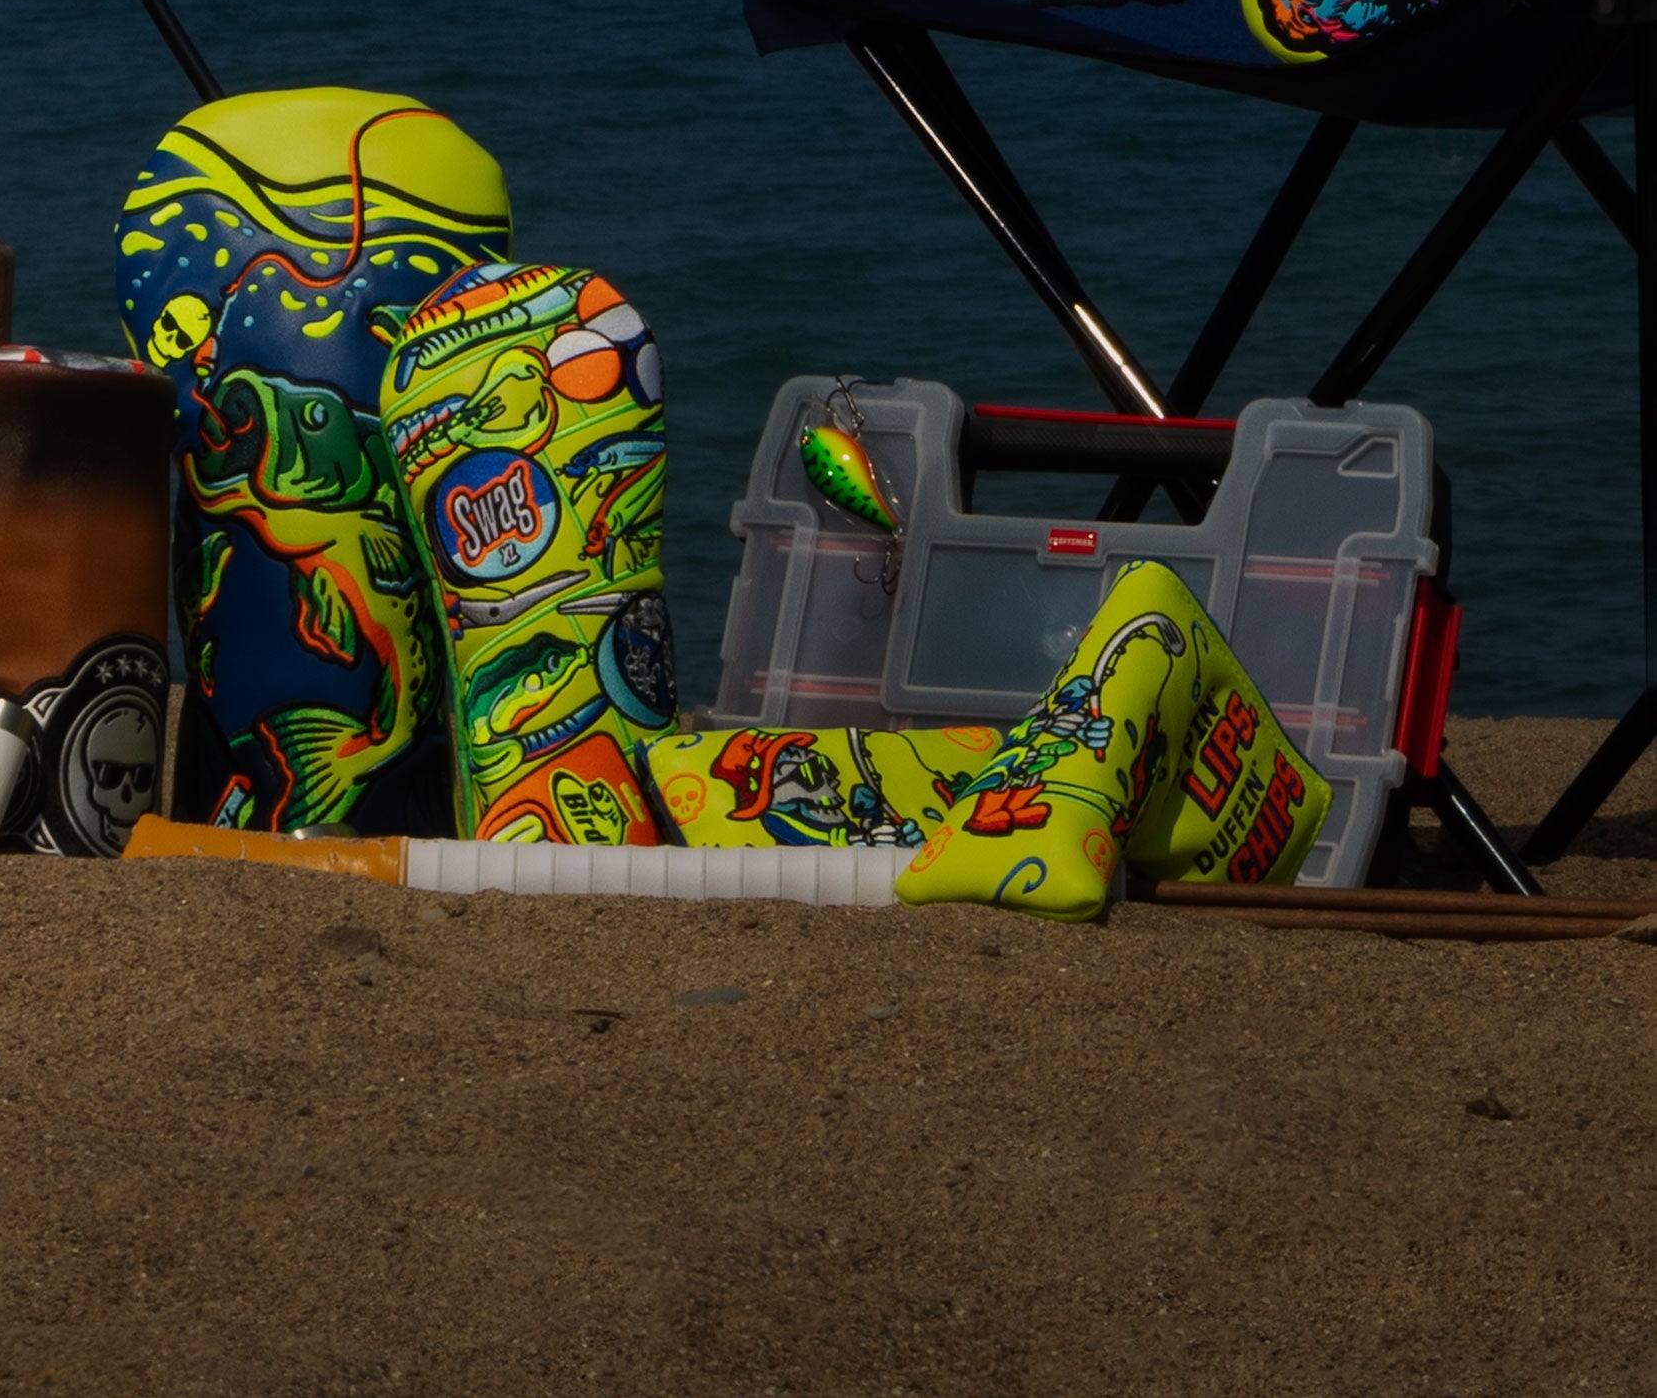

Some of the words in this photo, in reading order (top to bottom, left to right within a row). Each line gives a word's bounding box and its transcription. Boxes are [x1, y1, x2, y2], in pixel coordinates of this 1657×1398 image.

[454, 469, 535, 559] Swag
[499, 543, 519, 566] XL
[1226, 749, 1306, 884] CHIPS
